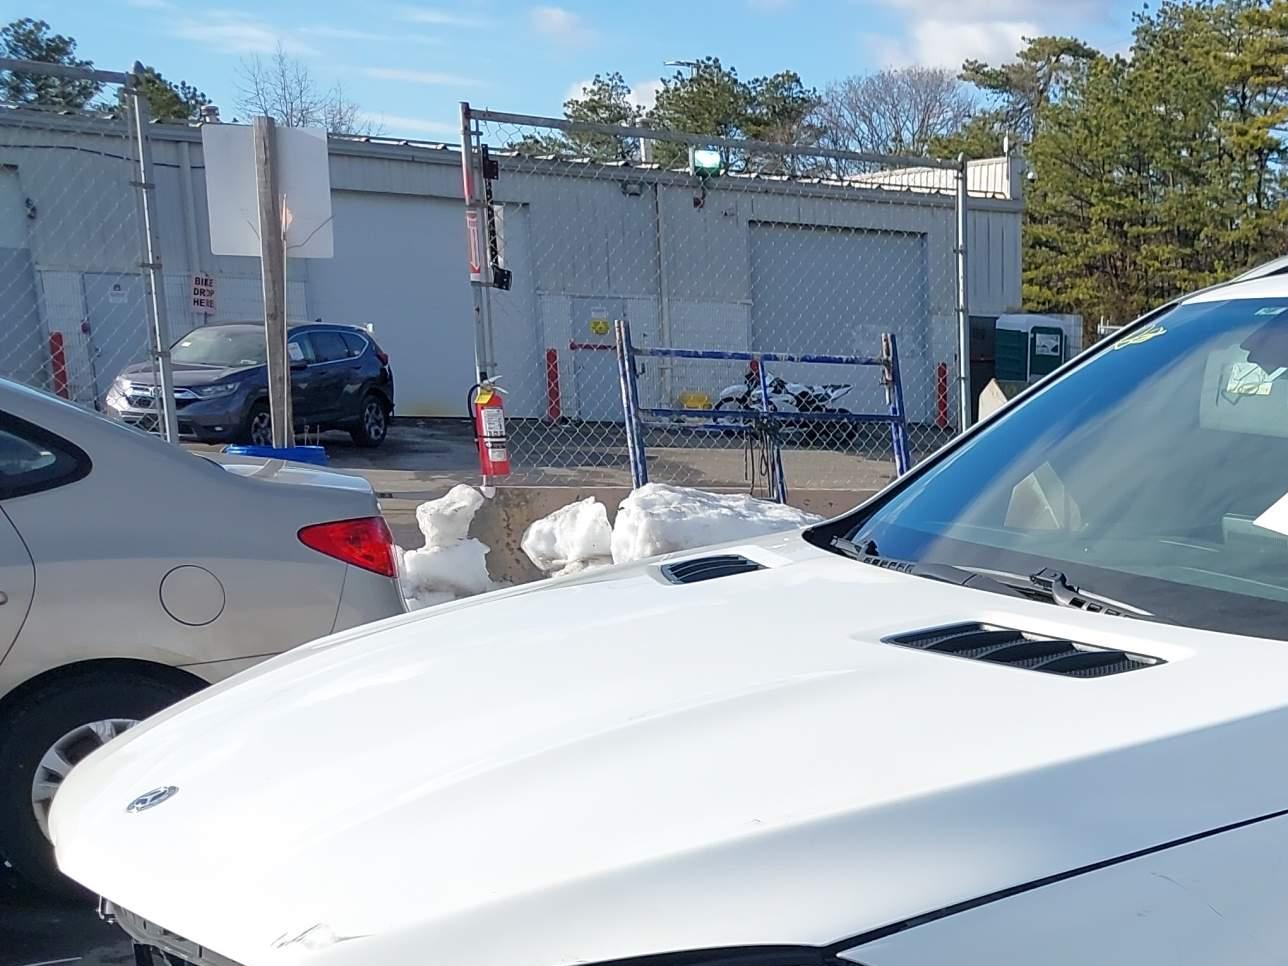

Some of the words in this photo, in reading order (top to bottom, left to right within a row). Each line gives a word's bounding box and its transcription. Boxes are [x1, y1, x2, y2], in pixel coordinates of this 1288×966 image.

[194, 276, 214, 288] BIKE
[193, 287, 215, 297] DROP
[193, 298, 214, 308] HERE
